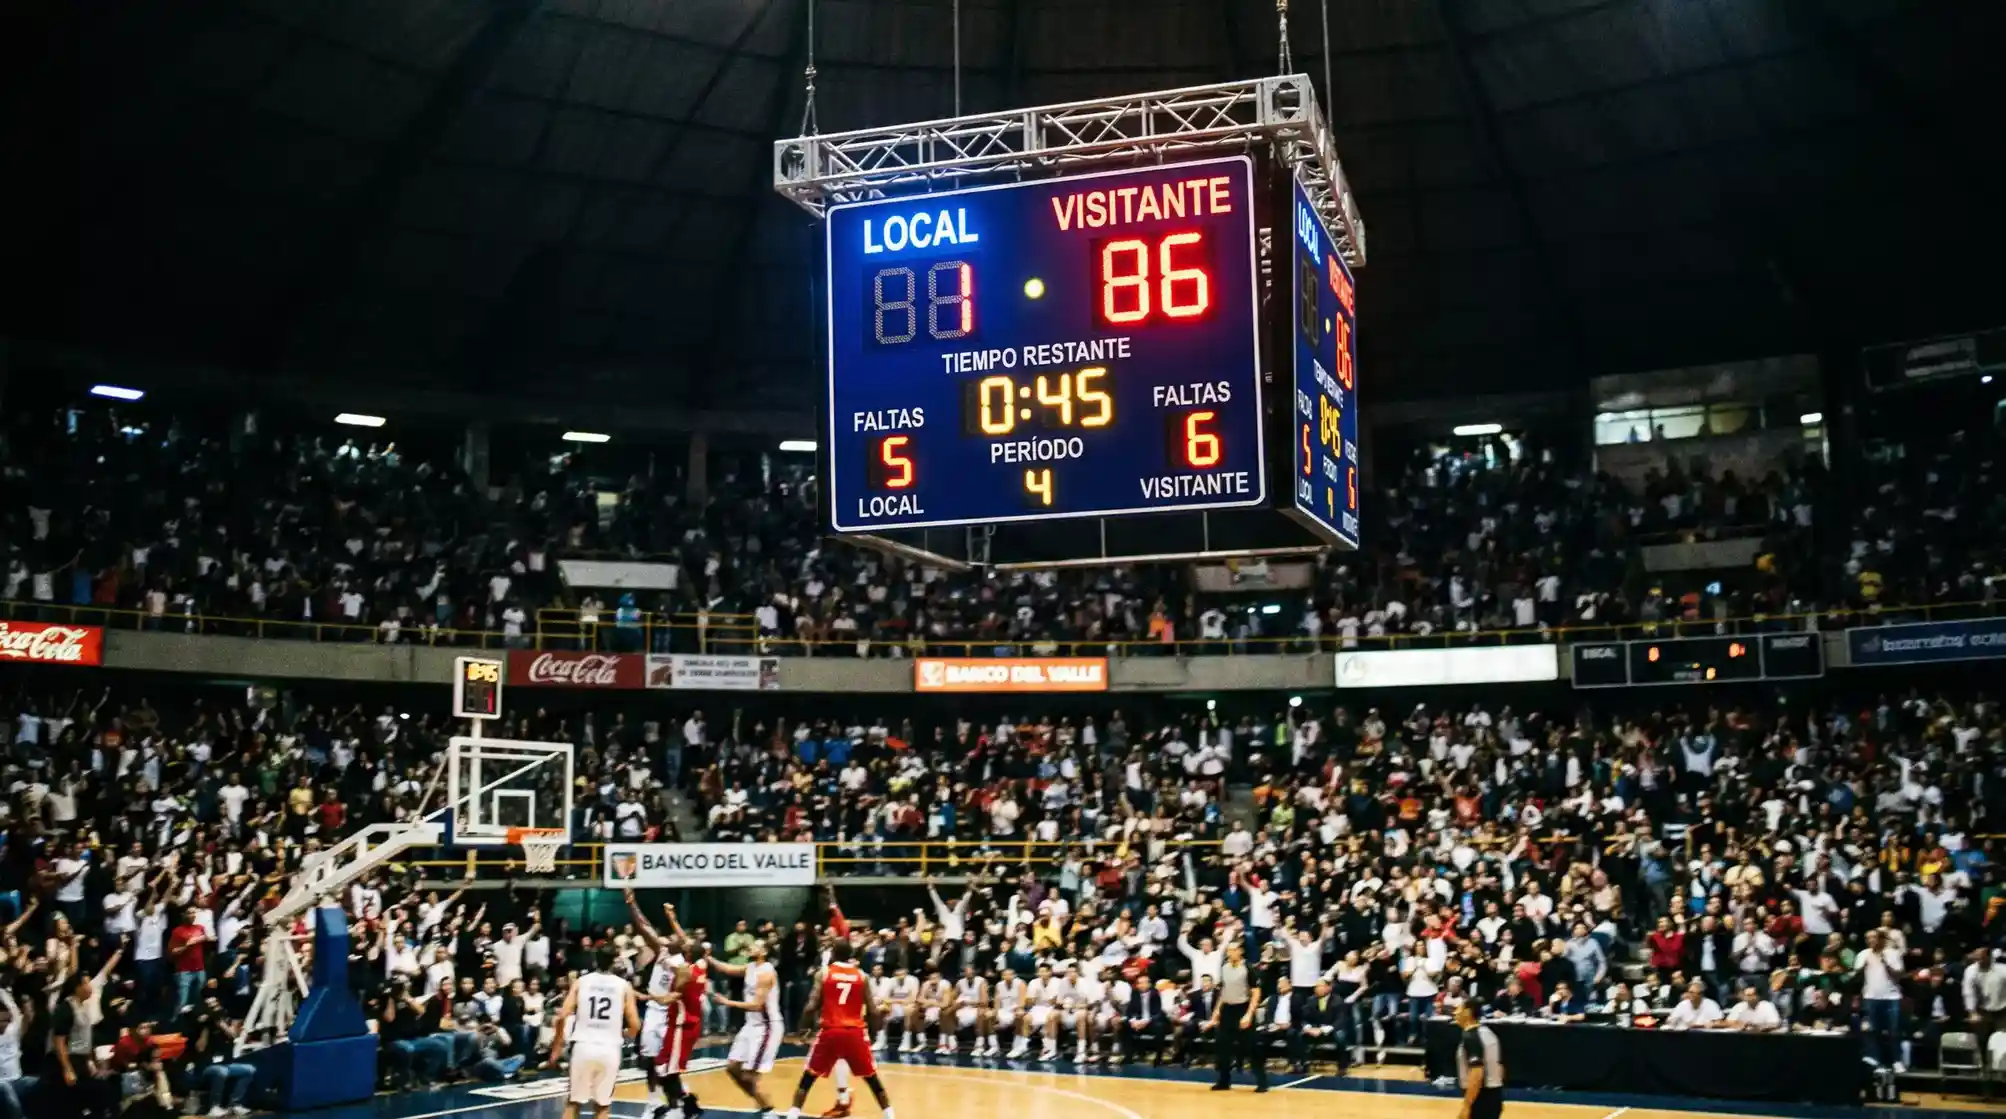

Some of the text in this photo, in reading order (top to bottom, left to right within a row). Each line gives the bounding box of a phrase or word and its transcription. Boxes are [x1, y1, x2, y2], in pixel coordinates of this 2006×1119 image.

[1052, 176, 1232, 231] VISITANTE
[864, 208, 979, 254] LOCAL
[1102, 231, 1209, 323] 86
[941, 337, 1131, 374] TIEMPO RESTANTE
[979, 366, 1113, 435] 0:45
[1153, 380, 1231, 407] FALTAS
[853, 407, 925, 432] FALTAS
[990, 436, 1084, 464] PERÍODO
[1187, 411, 1220, 466] 6
[883, 436, 912, 488] 5
[1025, 468, 1052, 506] 4
[1140, 471, 1250, 499] VISITANTE
[858, 494, 925, 518] LOCAL
[642, 852, 810, 870] BANCO DEL VALLE
[588, 996, 612, 1020] 12
[836, 982, 853, 1005] 7
